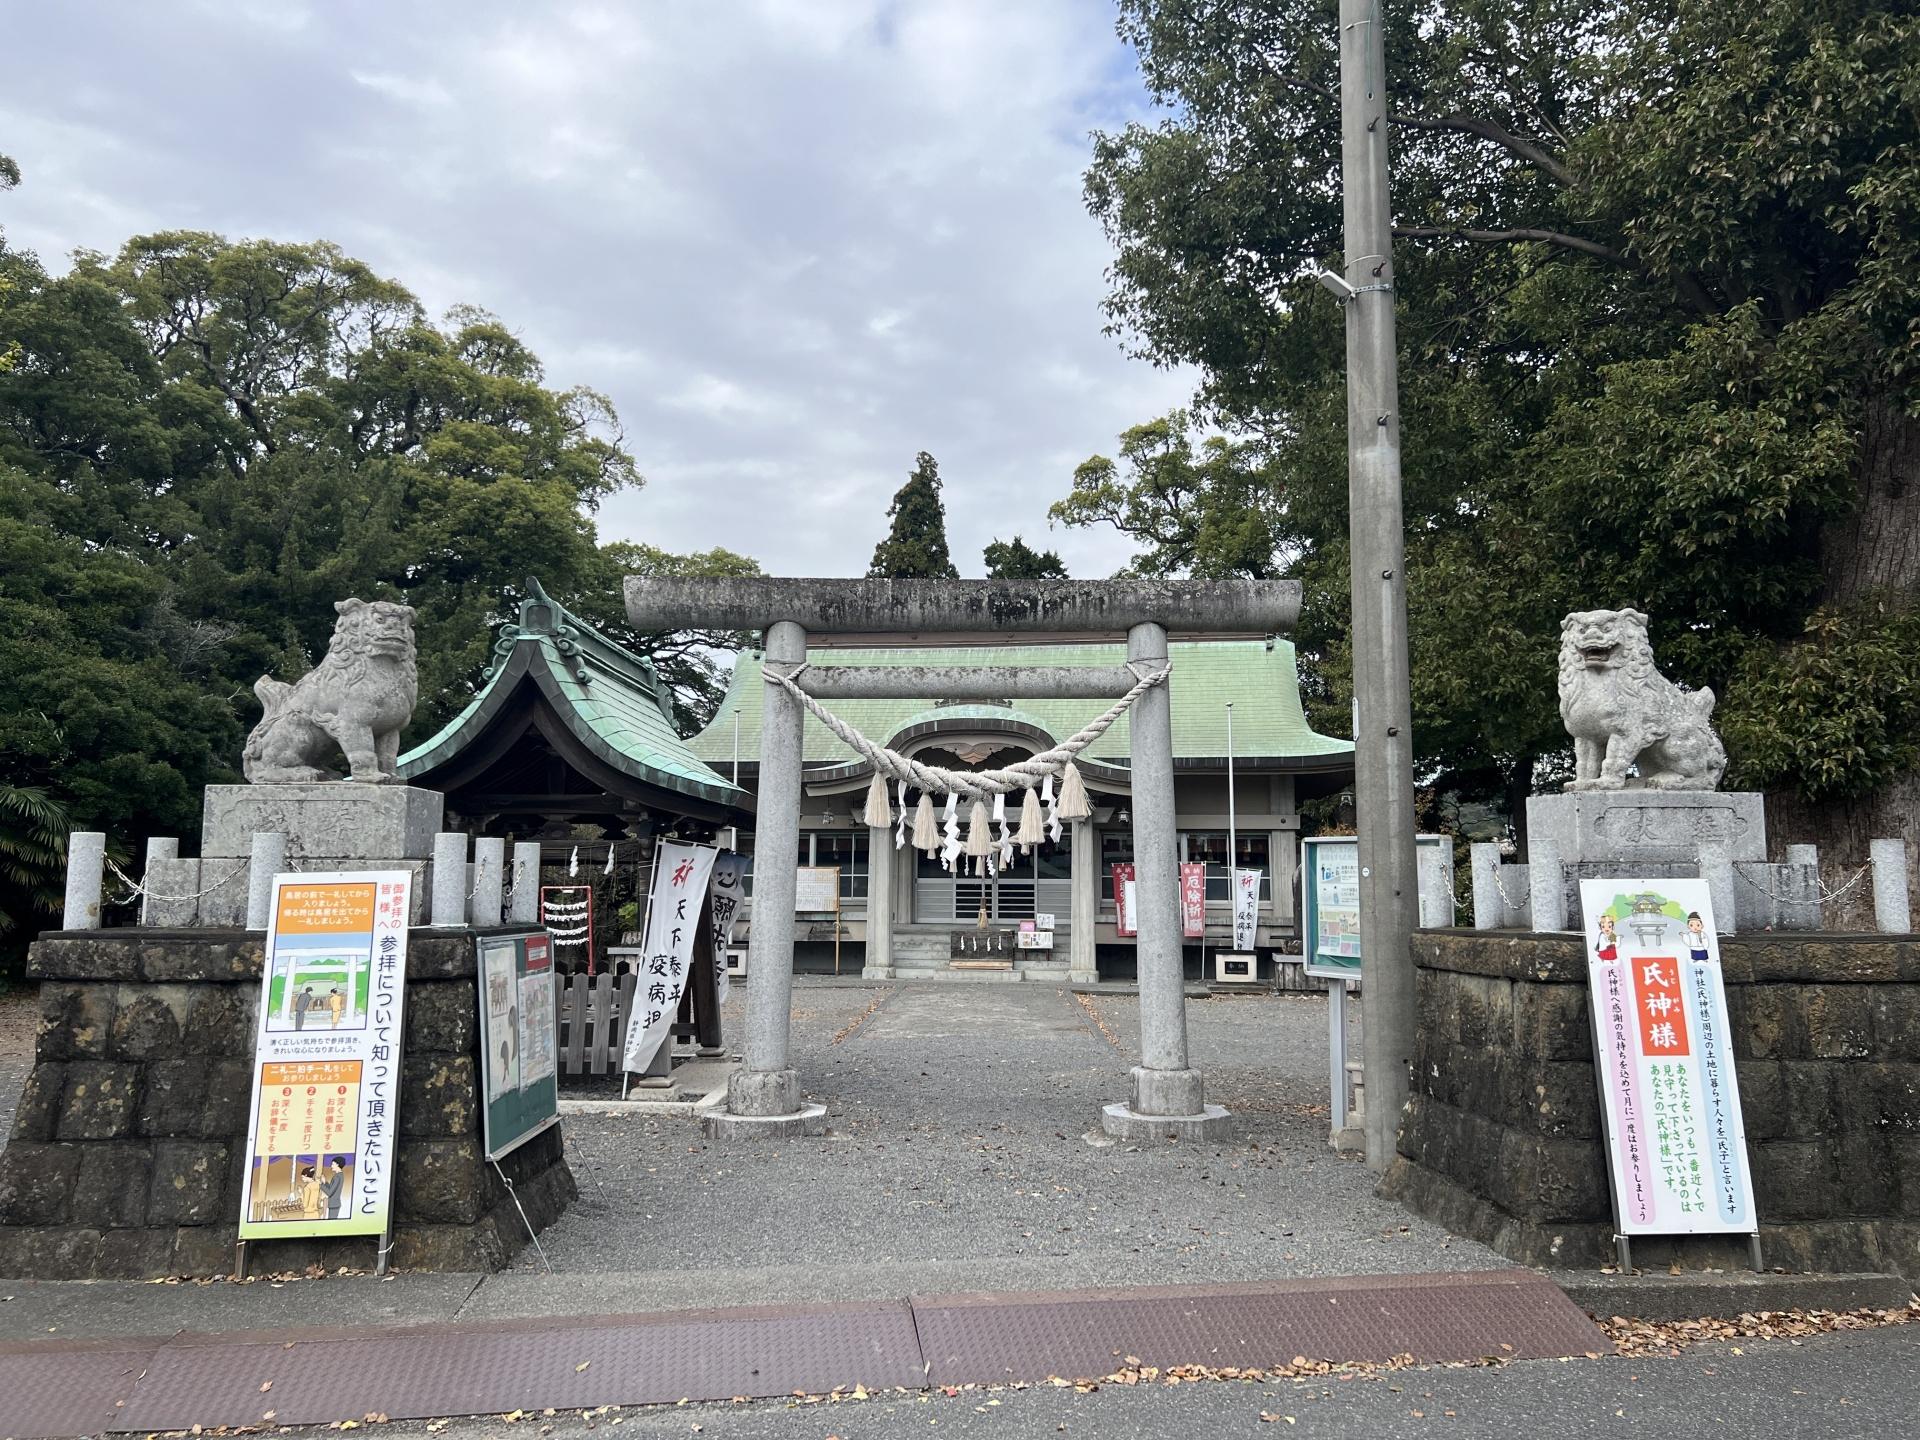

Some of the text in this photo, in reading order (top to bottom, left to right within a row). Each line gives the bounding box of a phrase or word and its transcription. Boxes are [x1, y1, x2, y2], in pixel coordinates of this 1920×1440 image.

[285, 890, 370, 899] 鳥居の前で一礼してから
[671, 858, 695, 889] 祈
[1241, 875, 1254, 888] 祈
[297, 917, 354, 926] 一礼しましょう。
[303, 900, 351, 908] 入りましょう。
[378, 884, 392, 929] 皆様へ
[391, 883, 405, 929] 御参拝の
[1186, 875, 1203, 931] 厄除祈願
[668, 899, 687, 1005] 天下泰平
[1643, 962, 1678, 1049] 氏神様
[270, 1064, 354, 1074] 二礼二拍手一礼をして
[273, 1046, 357, 1055] きれいな心になりましょう。
[282, 1074, 341, 1083] お参りしましょう
[361, 935, 398, 1214] 参拝について知って頂きたいこと
[1607, 968, 1646, 1221] 氏神様へ感謝の気持ちを込めて月に一度はお参りしましょう
[268, 1099, 279, 1152] お辞儀をする
[279, 1099, 290, 1132] 深く一度
[303, 1098, 315, 1151] 手を二度打つ
[324, 1098, 335, 1150] お辞儀をする
[335, 1097, 346, 1132] 深く二度
[1650, 1063, 1678, 1194] あなたの「氏神様」です。
[1663, 1064, 1692, 1213] 見守って下さっているのは
[1676, 1063, 1705, 1213] あなたをいつも一番近くで
